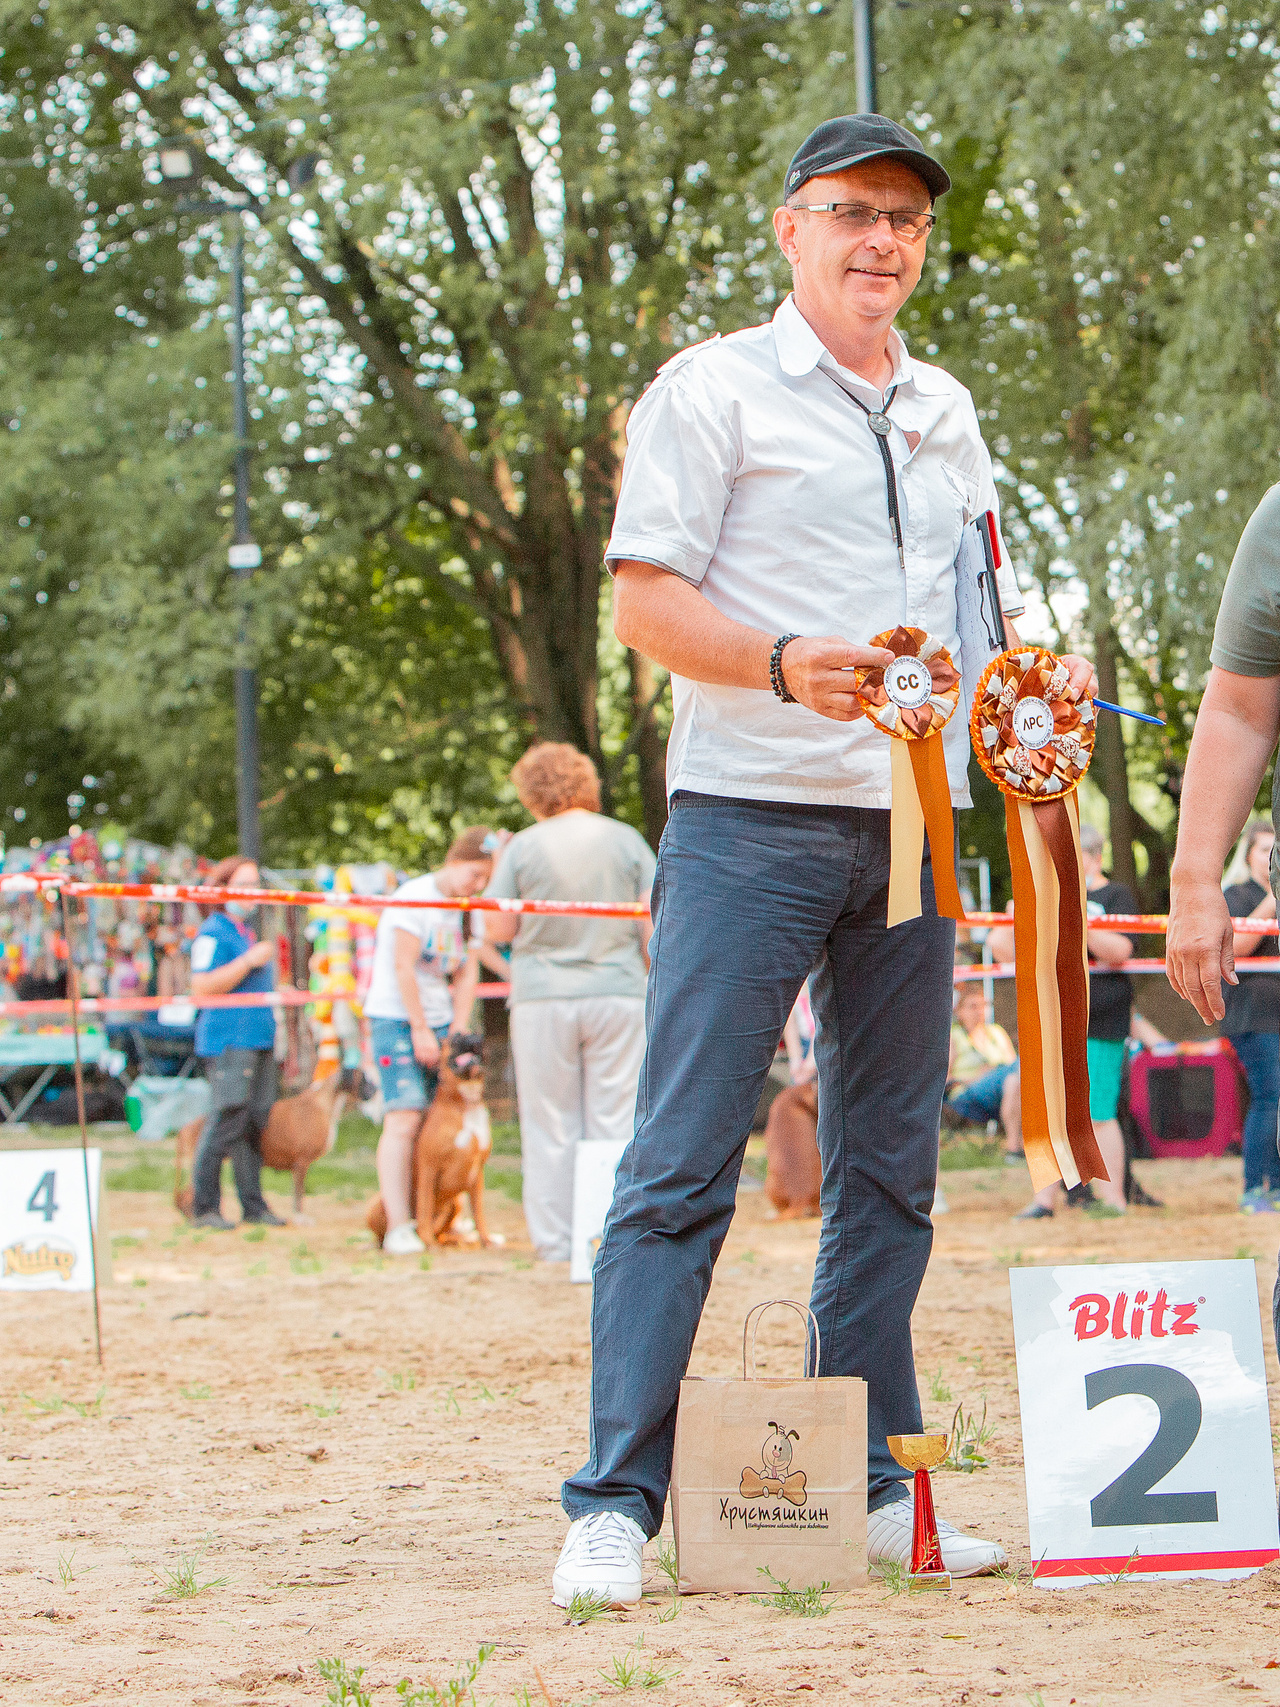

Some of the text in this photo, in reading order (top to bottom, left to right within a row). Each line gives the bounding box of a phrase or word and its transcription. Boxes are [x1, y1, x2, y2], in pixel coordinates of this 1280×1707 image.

[26, 1169, 59, 1222] 4
[3, 1242, 74, 1281] Nutro
[1084, 1363, 1219, 1527] 2
[719, 1497, 829, 1529] Хрустяшкин
